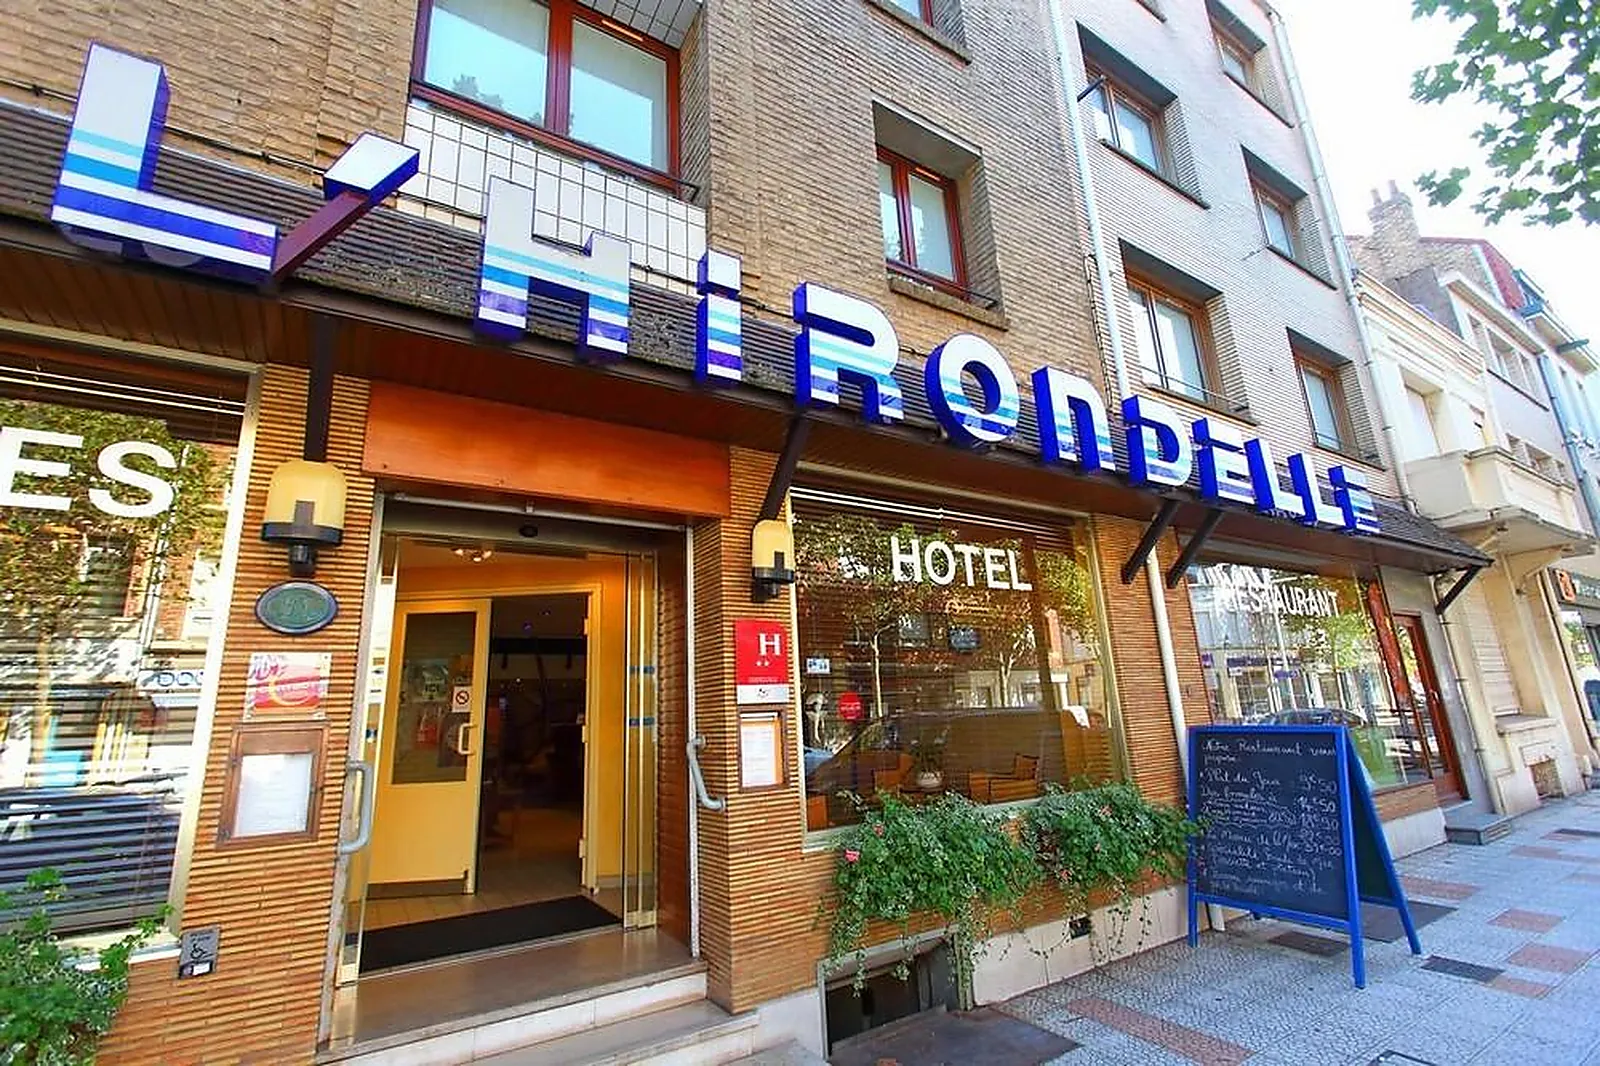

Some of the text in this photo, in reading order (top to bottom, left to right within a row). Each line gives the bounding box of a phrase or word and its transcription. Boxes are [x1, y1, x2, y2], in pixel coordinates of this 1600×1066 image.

[890, 536, 1033, 592] HOTEL
[1214, 584, 1341, 618] RESTAURANT
[758, 633, 781, 656] H
